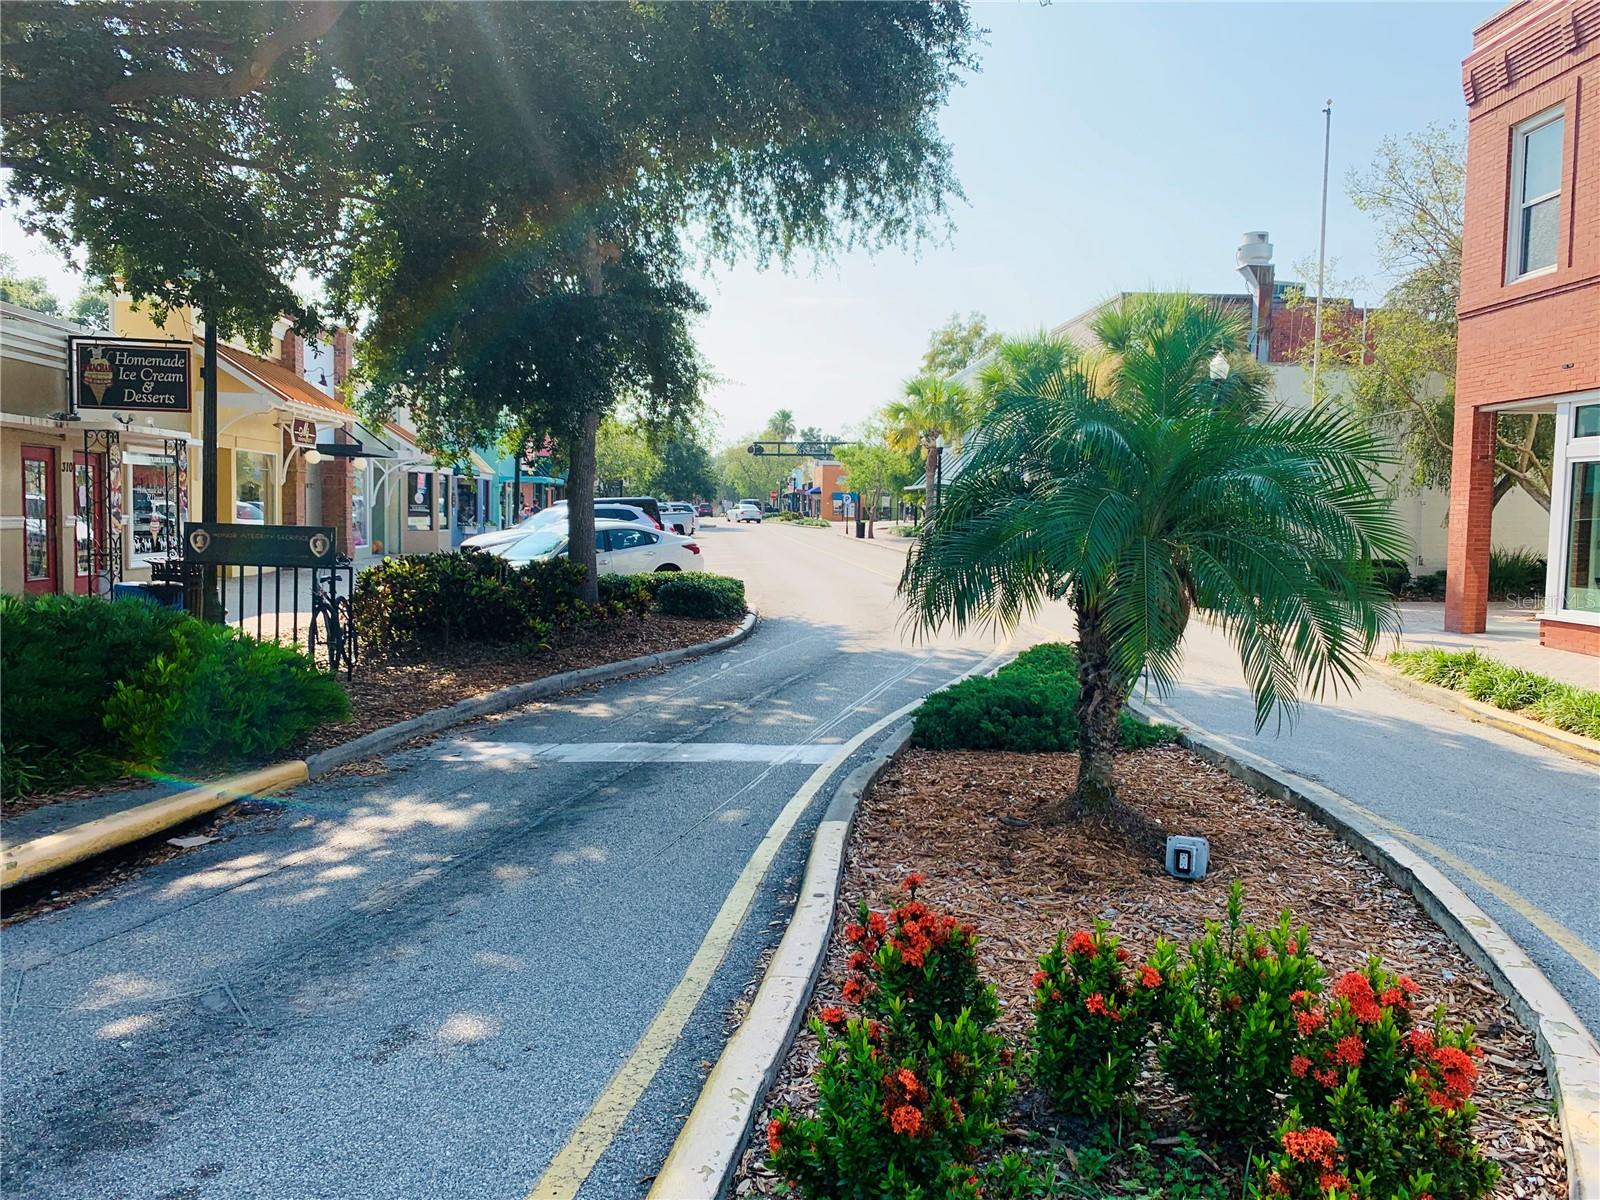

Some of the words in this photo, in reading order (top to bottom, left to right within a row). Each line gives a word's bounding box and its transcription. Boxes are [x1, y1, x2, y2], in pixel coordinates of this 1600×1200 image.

[115, 351, 185, 367] Homemade
[119, 366, 137, 381] Ice
[140, 367, 184, 382] Cream
[142, 381, 155, 393] &
[124, 388, 175, 404] Desserts
[61, 461, 73, 472] 310
